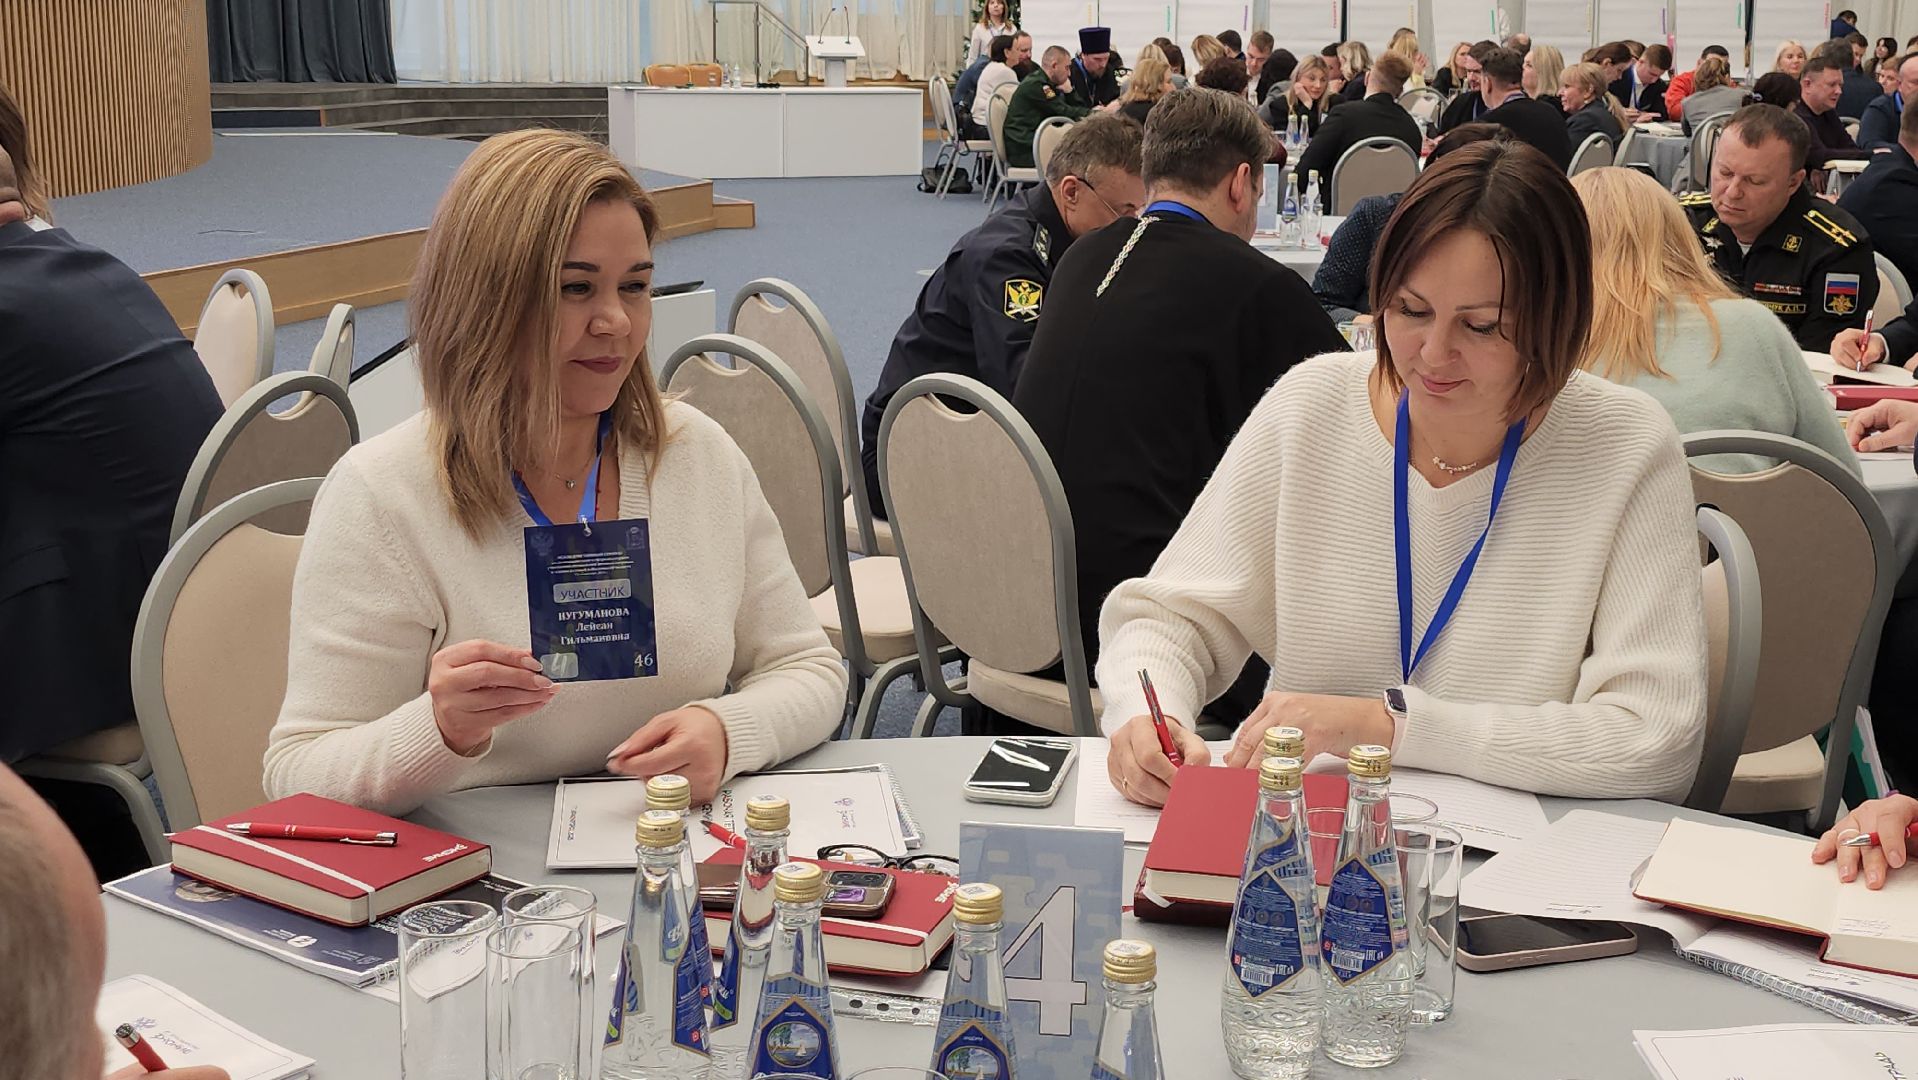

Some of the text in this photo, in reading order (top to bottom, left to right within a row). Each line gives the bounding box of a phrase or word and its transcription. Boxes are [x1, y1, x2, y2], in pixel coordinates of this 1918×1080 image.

[560, 586, 626, 601] УЧАСТНИК
[558, 607, 630, 621] НУГУМАНОВА
[575, 621, 613, 632] Лейсан
[634, 652, 654, 667] 46
[1003, 886, 1088, 1036] 4
